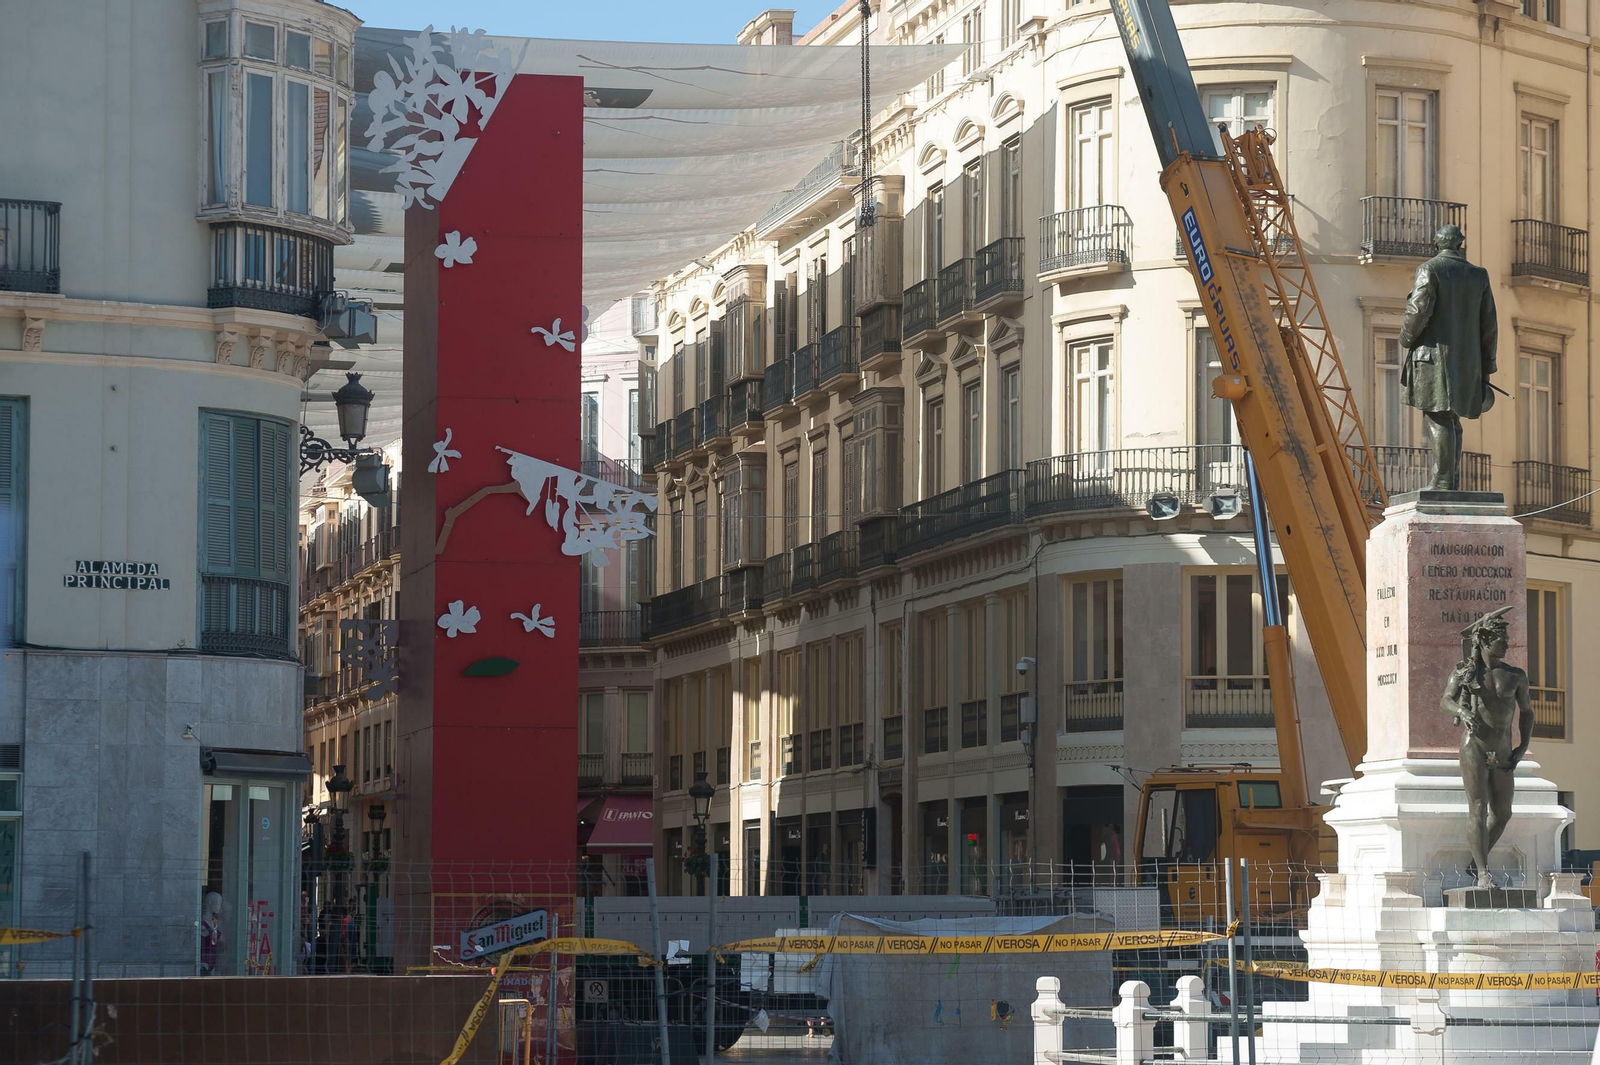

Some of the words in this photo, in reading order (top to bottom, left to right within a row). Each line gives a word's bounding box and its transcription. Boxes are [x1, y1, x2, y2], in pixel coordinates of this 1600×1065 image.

[1118, 0, 1141, 50] RUAS
[1430, 544, 1505, 557] INAUGURACION
[77, 561, 158, 575] ALAMEDA
[1428, 565, 1458, 578] ENERO
[65, 575, 169, 590] PRINCIPAL
[1428, 588, 1507, 602] RESTAURACION
[1441, 610, 1470, 623] MAYO
[492, 914, 544, 946] Miguel
[788, 938, 826, 950] VEROSA
[838, 940, 849, 949] NO
[850, 940, 875, 950] PASAR
[886, 938, 927, 950] VEROSA
[940, 940, 952, 949] NO
[954, 940, 982, 949] PASAR
[996, 938, 1040, 950] VEROSA
[1055, 938, 1069, 947] NO
[1071, 938, 1101, 947] PASAR
[1117, 932, 1164, 946] VEROSA
[1340, 973, 1351, 981] NO
[1352, 974, 1377, 982] PASAR
[1389, 974, 1427, 985] VEROSA
[1438, 976, 1449, 985] NO
[1450, 976, 1475, 985] PASAR
[1486, 976, 1523, 986] VEROSA
[1534, 977, 1546, 985] NO
[1547, 976, 1571, 985] PASAR
[1583, 975, 1600, 985] VER
